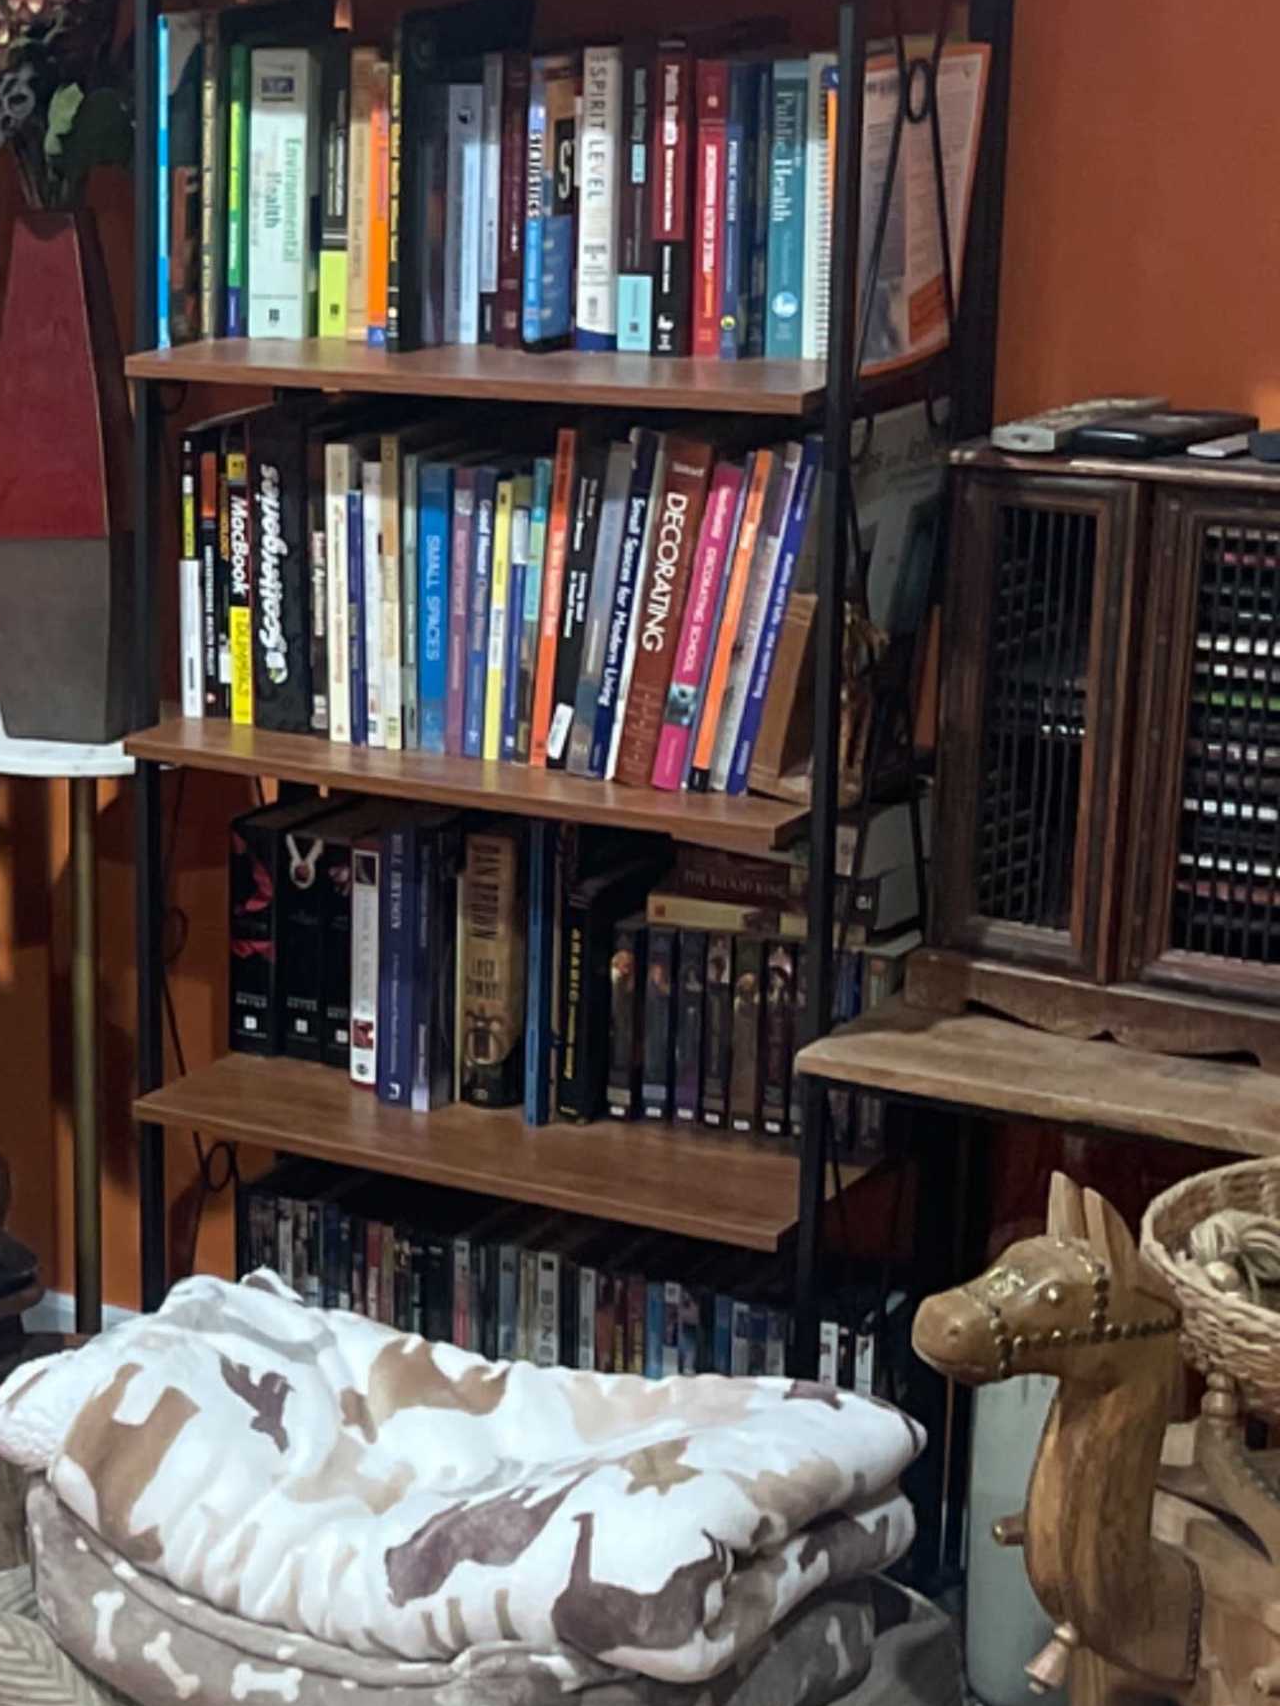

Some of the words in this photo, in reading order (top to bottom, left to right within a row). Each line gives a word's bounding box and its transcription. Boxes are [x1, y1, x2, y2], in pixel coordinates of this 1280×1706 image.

[585, 64, 610, 131] SPIRIT
[772, 90, 794, 149] Public
[262, 170, 283, 229] Health
[282, 136, 300, 261] Environmental
[524, 131, 544, 219] STATISTICS
[583, 136, 608, 201] LEVEL
[770, 156, 794, 222] Health
[227, 494, 248, 595] MacBook
[626, 496, 645, 535] Small
[252, 462, 291, 649] Scattergories
[425, 534, 440, 589] SMALL
[615, 535, 638, 583] Spaces
[639, 490, 688, 653] DECORATING
[688, 544, 720, 624] DECORATING
[425, 595, 440, 661] SPACES
[614, 585, 630, 608] for
[604, 608, 626, 665] Modern
[679, 623, 704, 674] SCHOOL
[595, 665, 616, 707] Living
